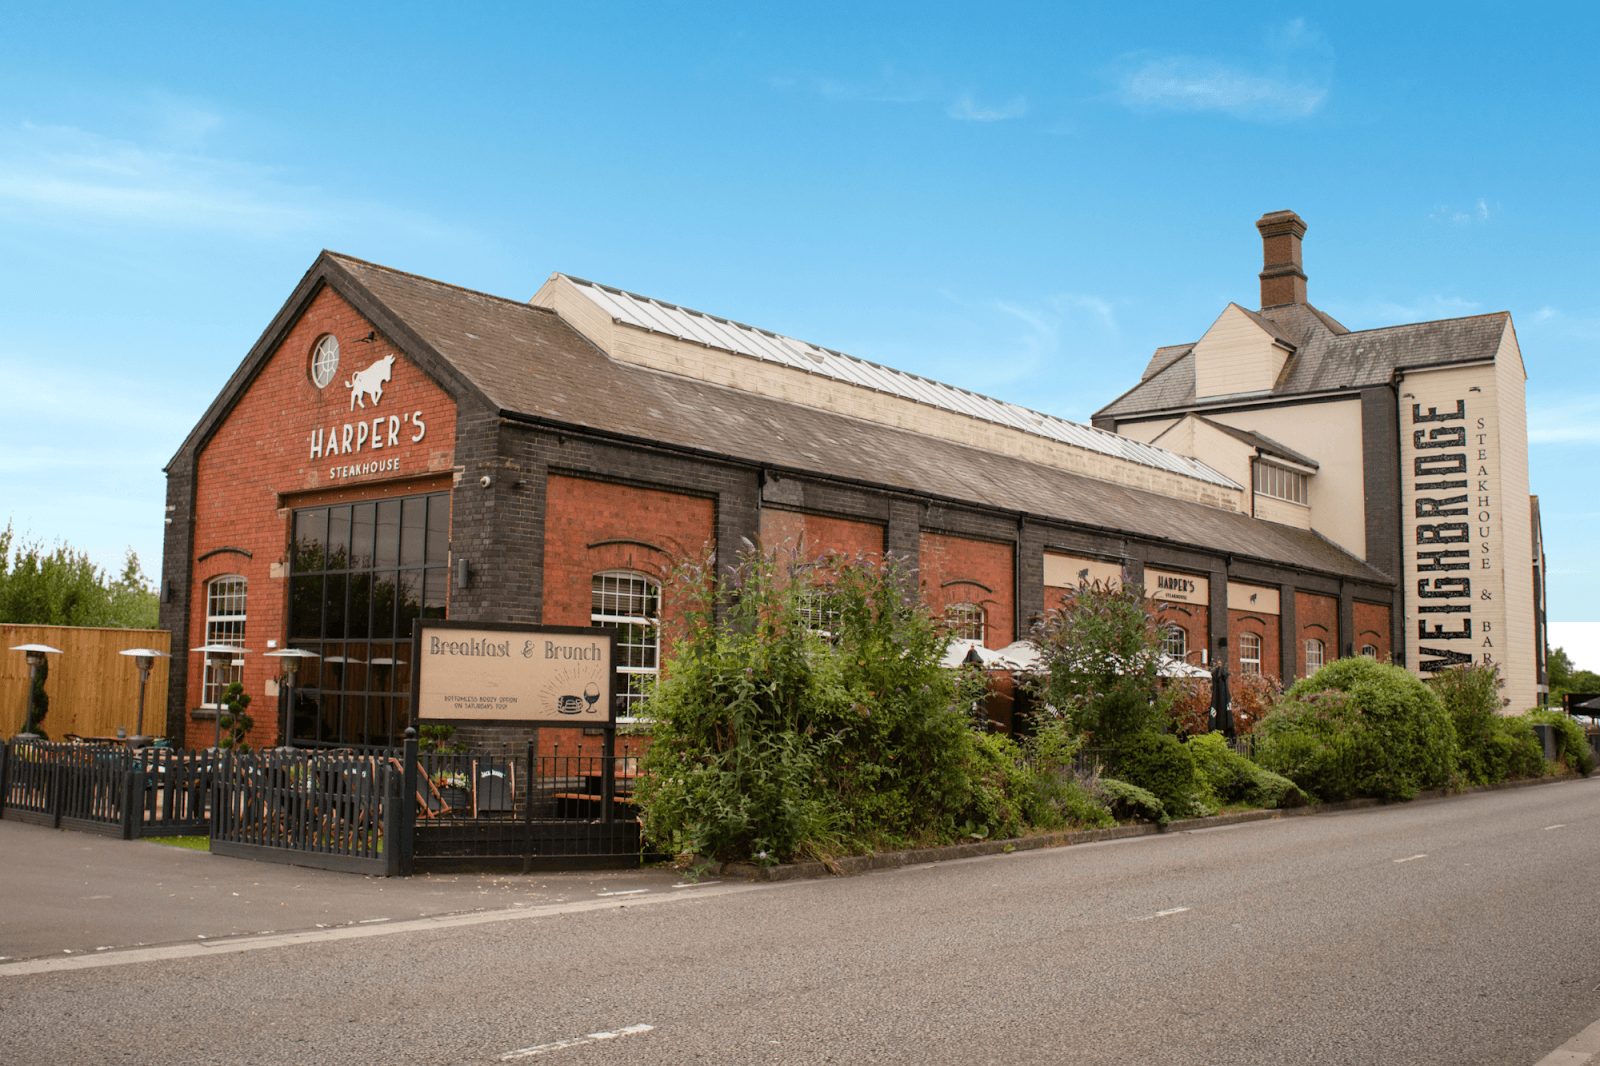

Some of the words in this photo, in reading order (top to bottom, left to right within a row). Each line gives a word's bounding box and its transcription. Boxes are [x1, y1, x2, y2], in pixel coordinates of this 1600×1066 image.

[310, 411, 426, 459] HARPER'S
[329, 457, 401, 479] STEAKHOUSE
[1476, 417, 1492, 569] STEAKHOUSE
[1157, 575, 1195, 593] HARPER'S
[1480, 588, 1493, 601] &
[429, 636, 511, 658] Breakfast
[520, 639, 536, 659] &
[544, 640, 602, 661] Brunch
[1481, 621, 1494, 664] BAR
